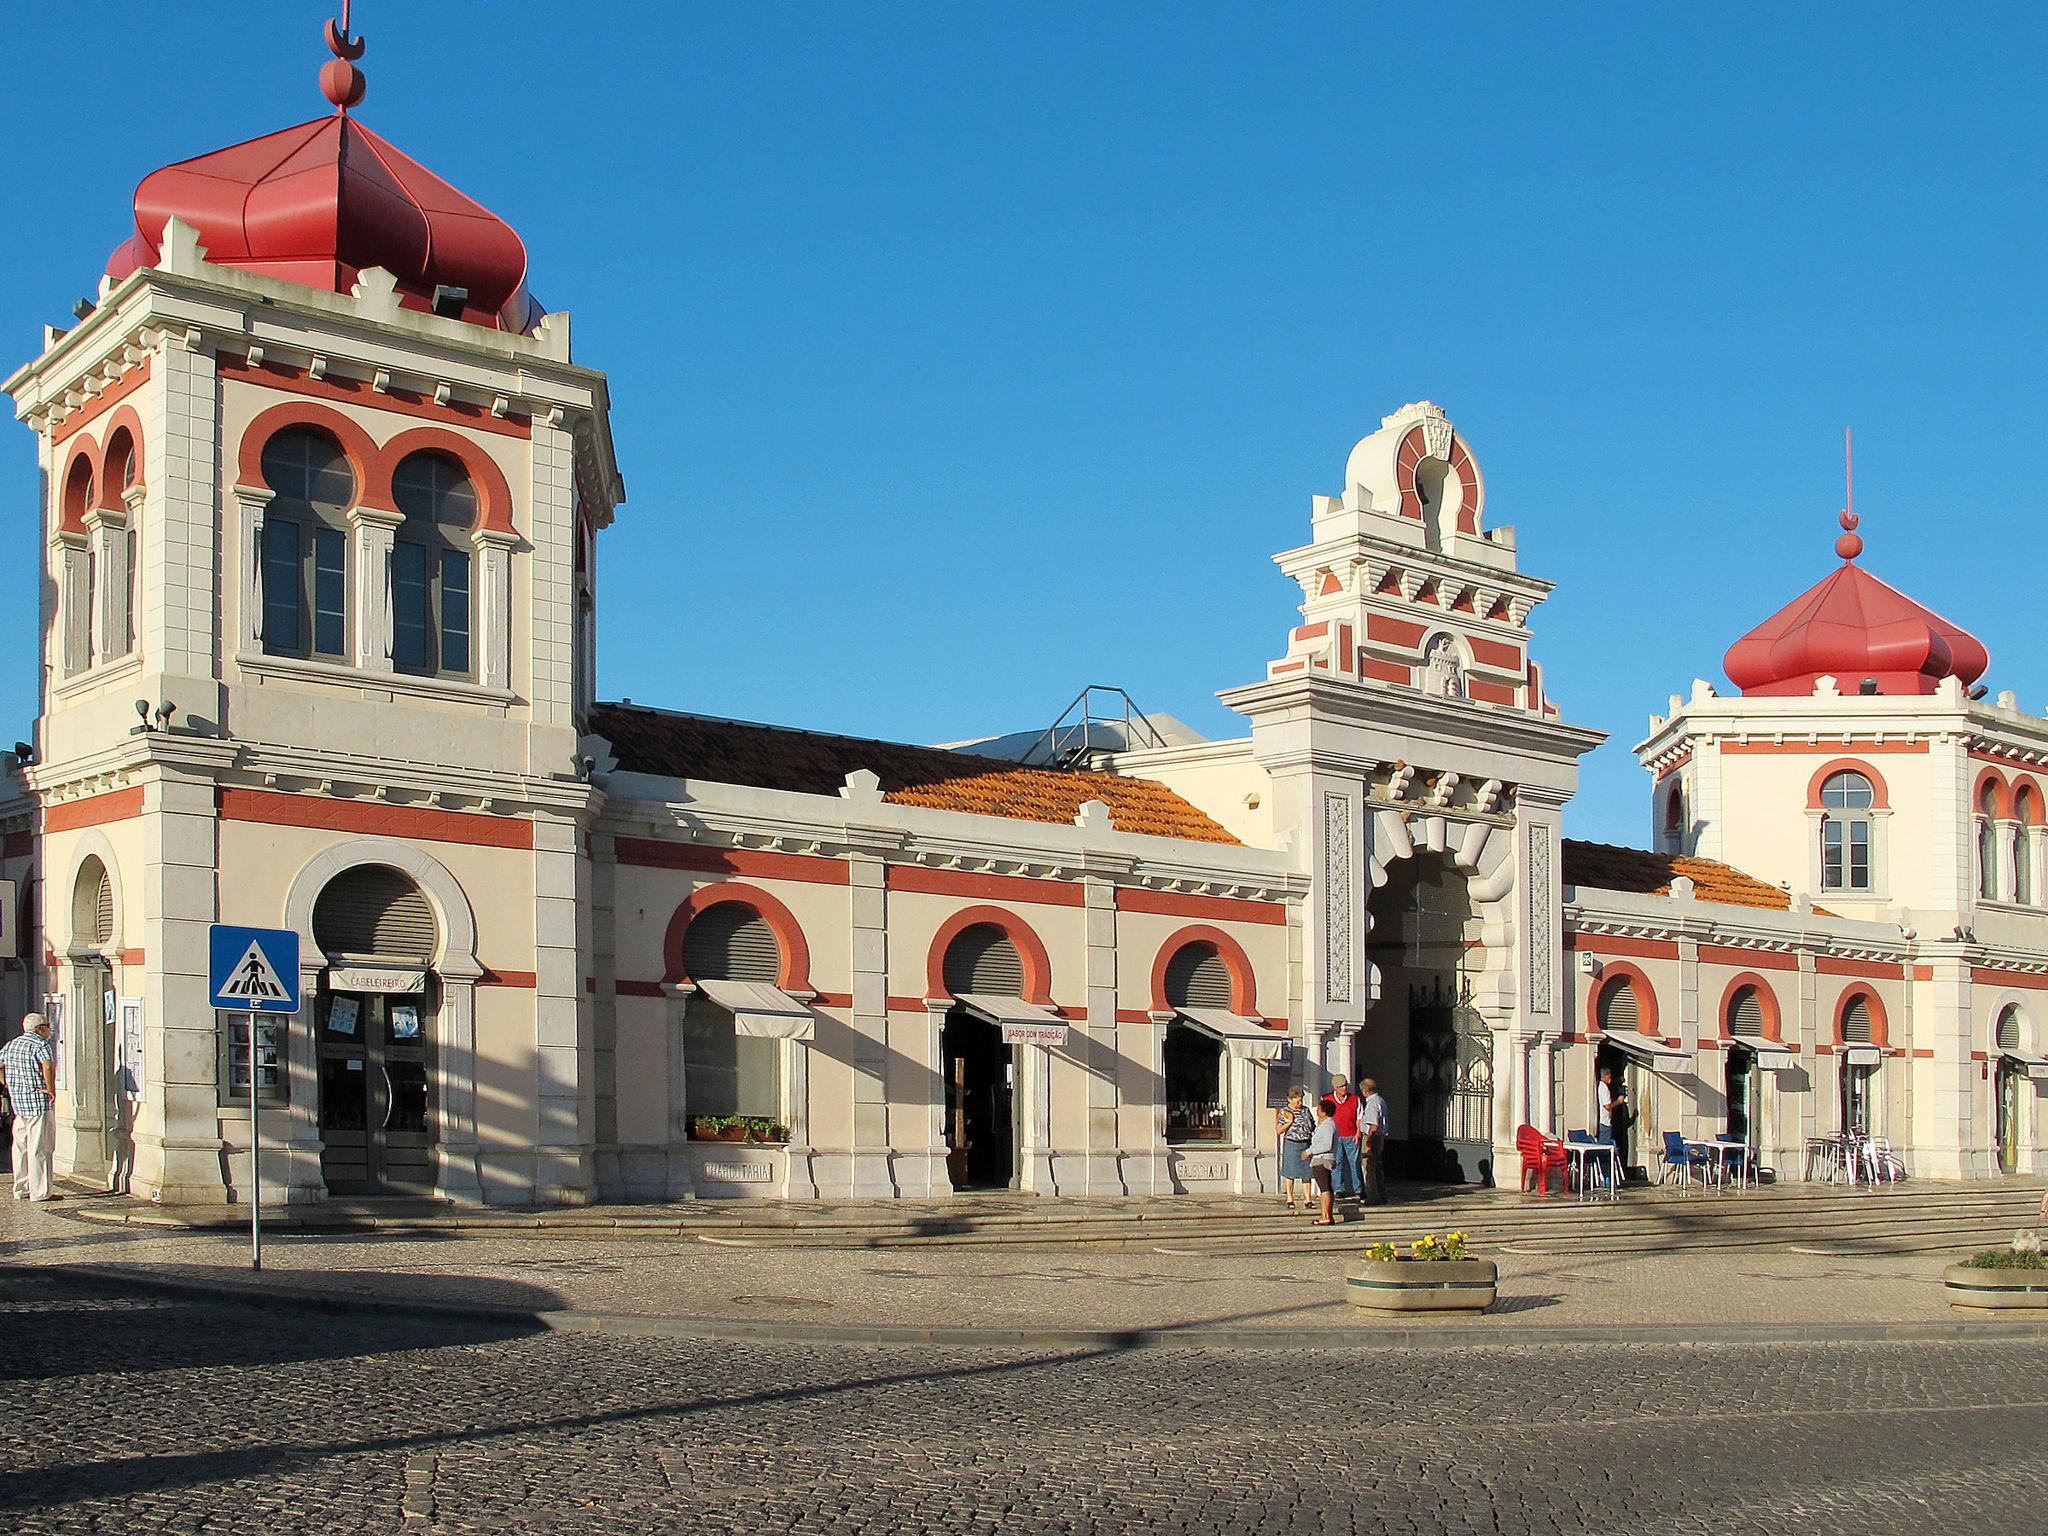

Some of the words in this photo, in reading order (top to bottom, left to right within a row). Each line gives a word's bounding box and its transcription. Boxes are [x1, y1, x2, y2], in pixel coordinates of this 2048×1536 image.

[350, 976, 406, 988] CABELEIREIRO
[1008, 1029, 1025, 1038] SABOR
[1038, 1029, 1063, 1040] TRADIÇÃO
[704, 1163, 769, 1180] CHARCUTARIA
